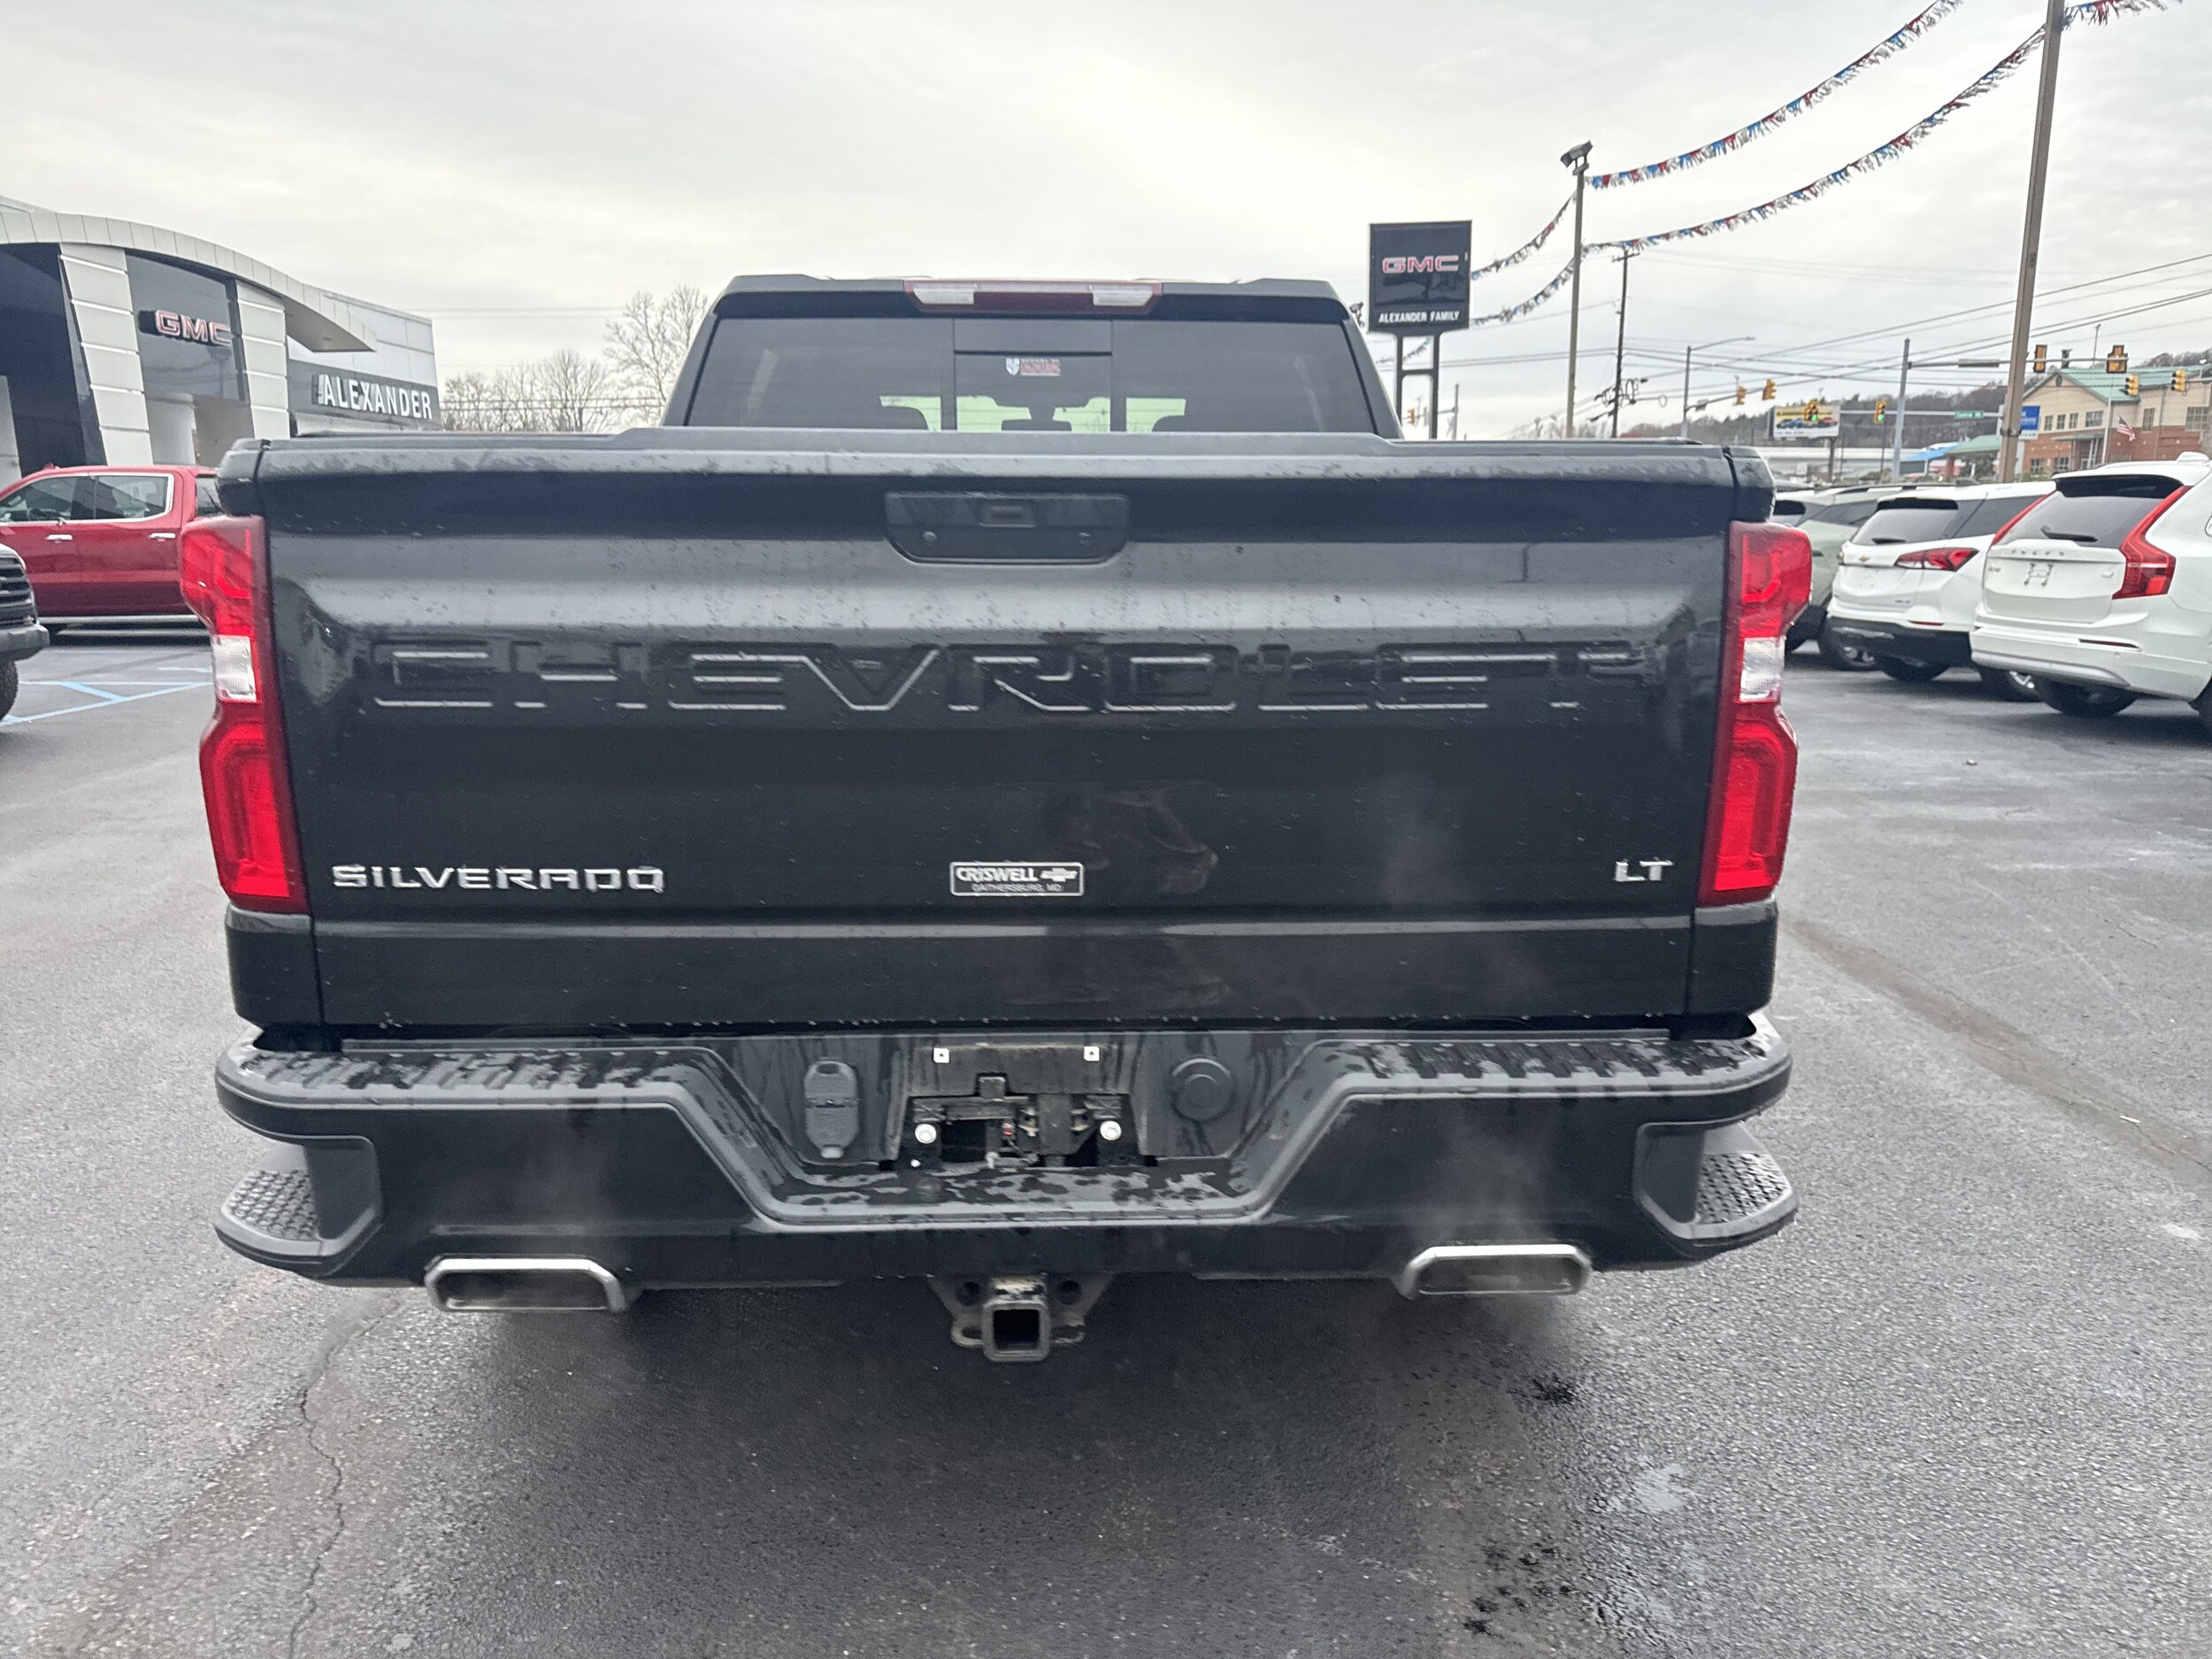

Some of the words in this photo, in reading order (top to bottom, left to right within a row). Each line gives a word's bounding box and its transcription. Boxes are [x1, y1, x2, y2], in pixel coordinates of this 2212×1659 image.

[1382, 255, 1459, 273] GMC
[155, 309, 232, 346] GMC
[1379, 311, 1427, 323] ALEXANDER
[1430, 311, 1460, 321] FAMILY
[319, 373, 432, 419] ALEXANDER
[370, 640, 1637, 711] CHEVROLET
[332, 865, 664, 894] SILVERADO
[956, 866, 1039, 883] CRISWELL
[1613, 859, 1674, 882] LT
